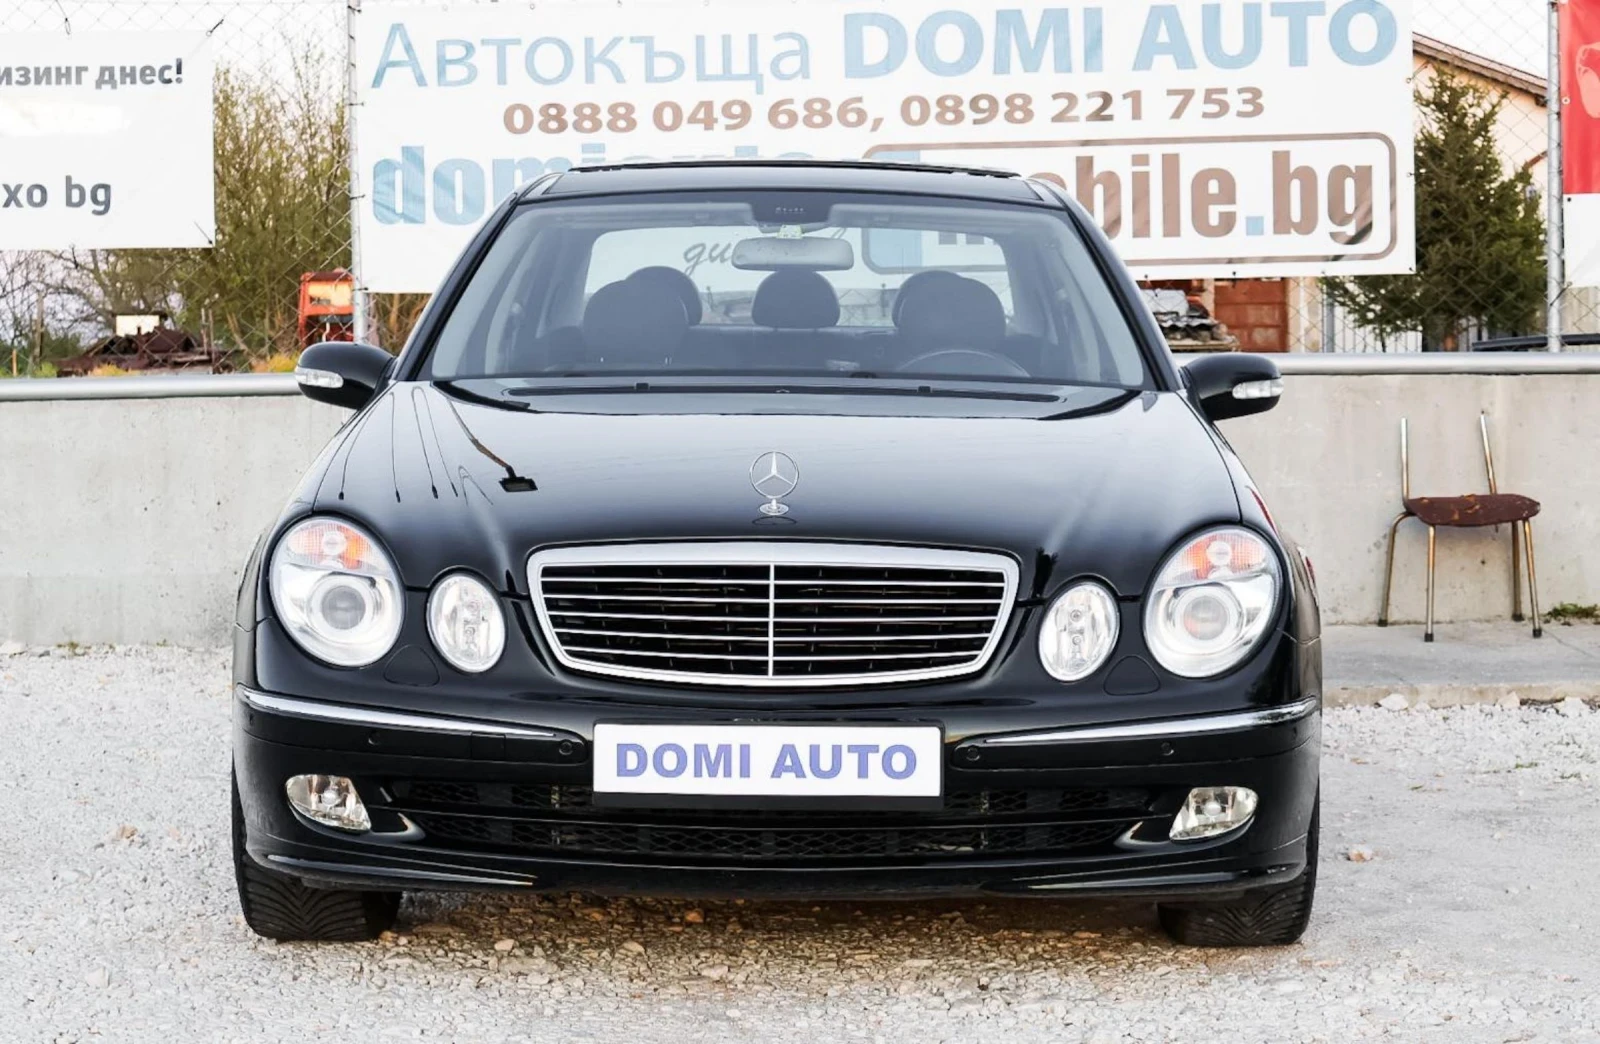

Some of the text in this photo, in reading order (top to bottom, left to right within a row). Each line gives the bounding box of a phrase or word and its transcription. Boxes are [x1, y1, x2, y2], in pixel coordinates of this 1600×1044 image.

[371, 0, 1398, 96] Автокъща DOMI AUTO
[95, 58, 183, 90] днес!
[503, 86, 1265, 135] 0888 049 686, 0898 221 753
[65, 175, 112, 216] bg
[616, 743, 918, 780] DOMI AUTO
